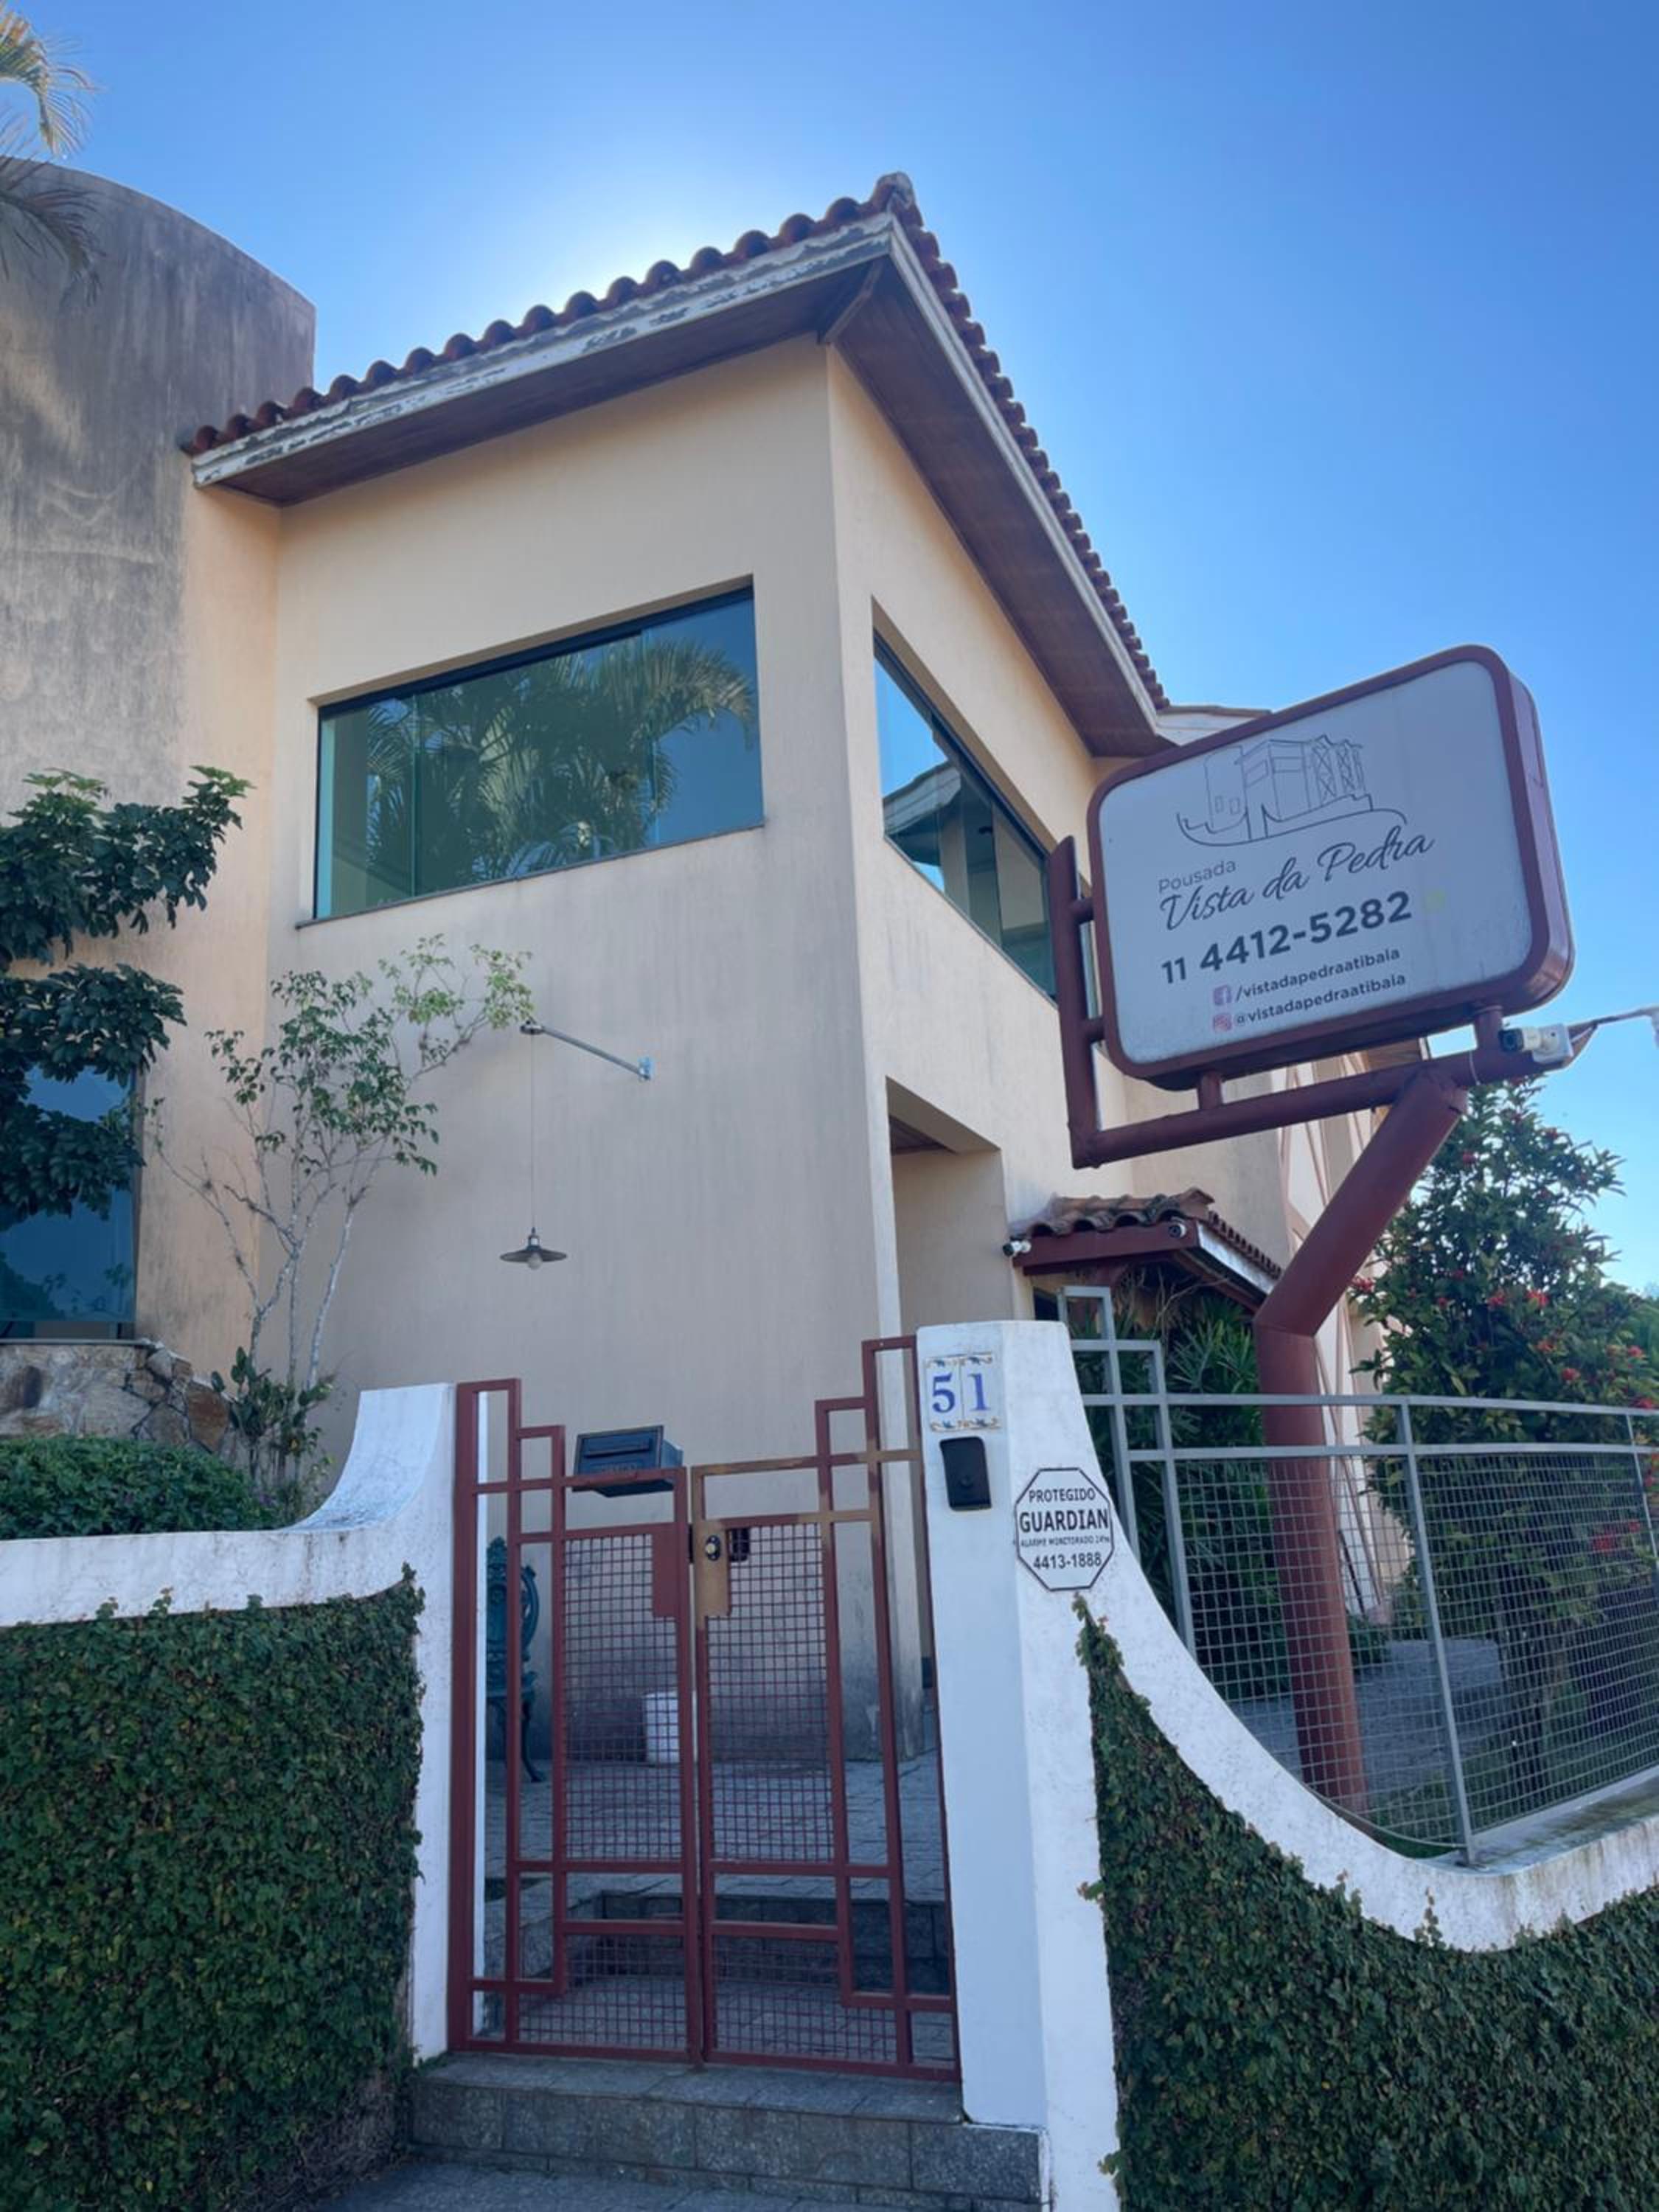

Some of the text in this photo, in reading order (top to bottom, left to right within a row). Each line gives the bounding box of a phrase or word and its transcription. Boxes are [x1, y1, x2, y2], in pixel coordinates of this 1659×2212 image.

[1158, 859, 1237, 894] Pousada
[1160, 825, 1436, 931] Vista da Pedra
[1161, 890, 1413, 984] 11 4412-5282
[932, 1372, 991, 1413] 51
[1029, 1487, 1096, 1503] PROTEGIDO
[1019, 1509, 1109, 1533] GUARDIAN
[1033, 1551, 1102, 1569] 4413-1888
